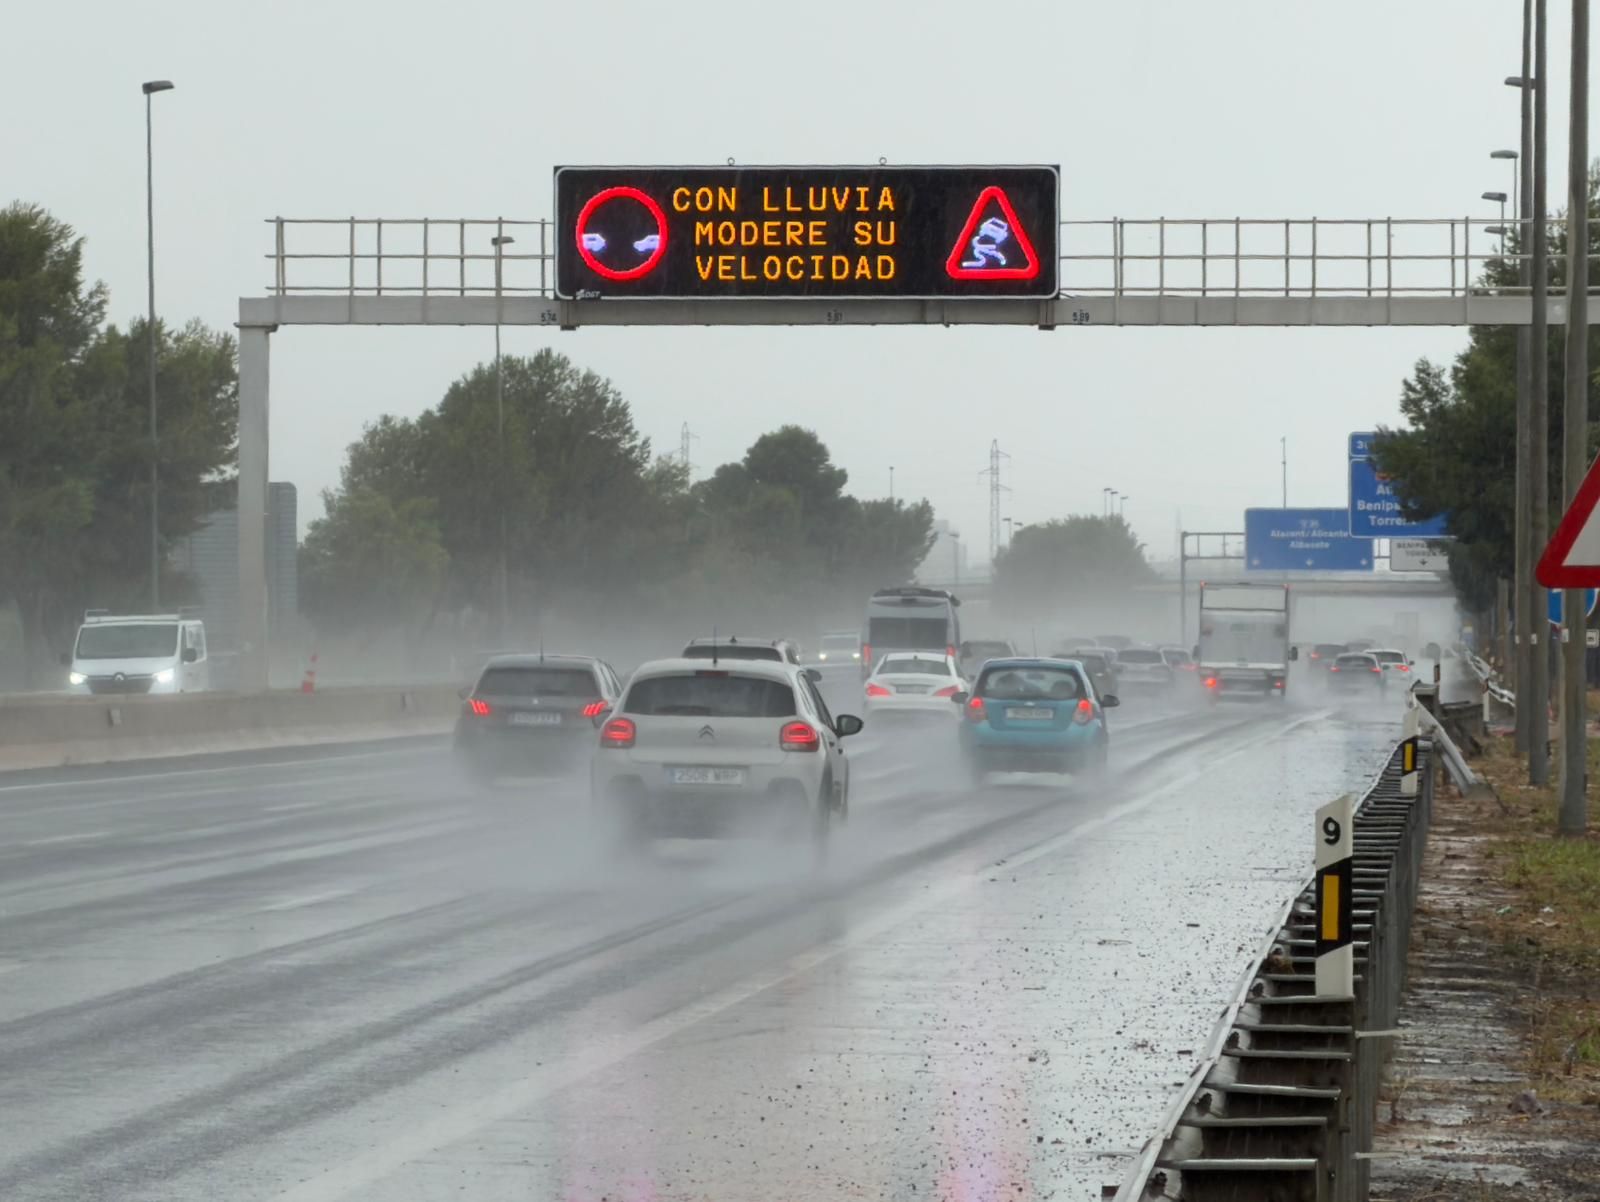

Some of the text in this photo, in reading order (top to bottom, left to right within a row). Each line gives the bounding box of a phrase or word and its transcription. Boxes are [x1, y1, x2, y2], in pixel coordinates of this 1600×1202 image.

[673, 186, 893, 211] CON LLUVIA
[695, 221, 894, 245] MODERE SU
[695, 255, 894, 279] VELOCIDAD
[1322, 816, 1341, 845] 9
